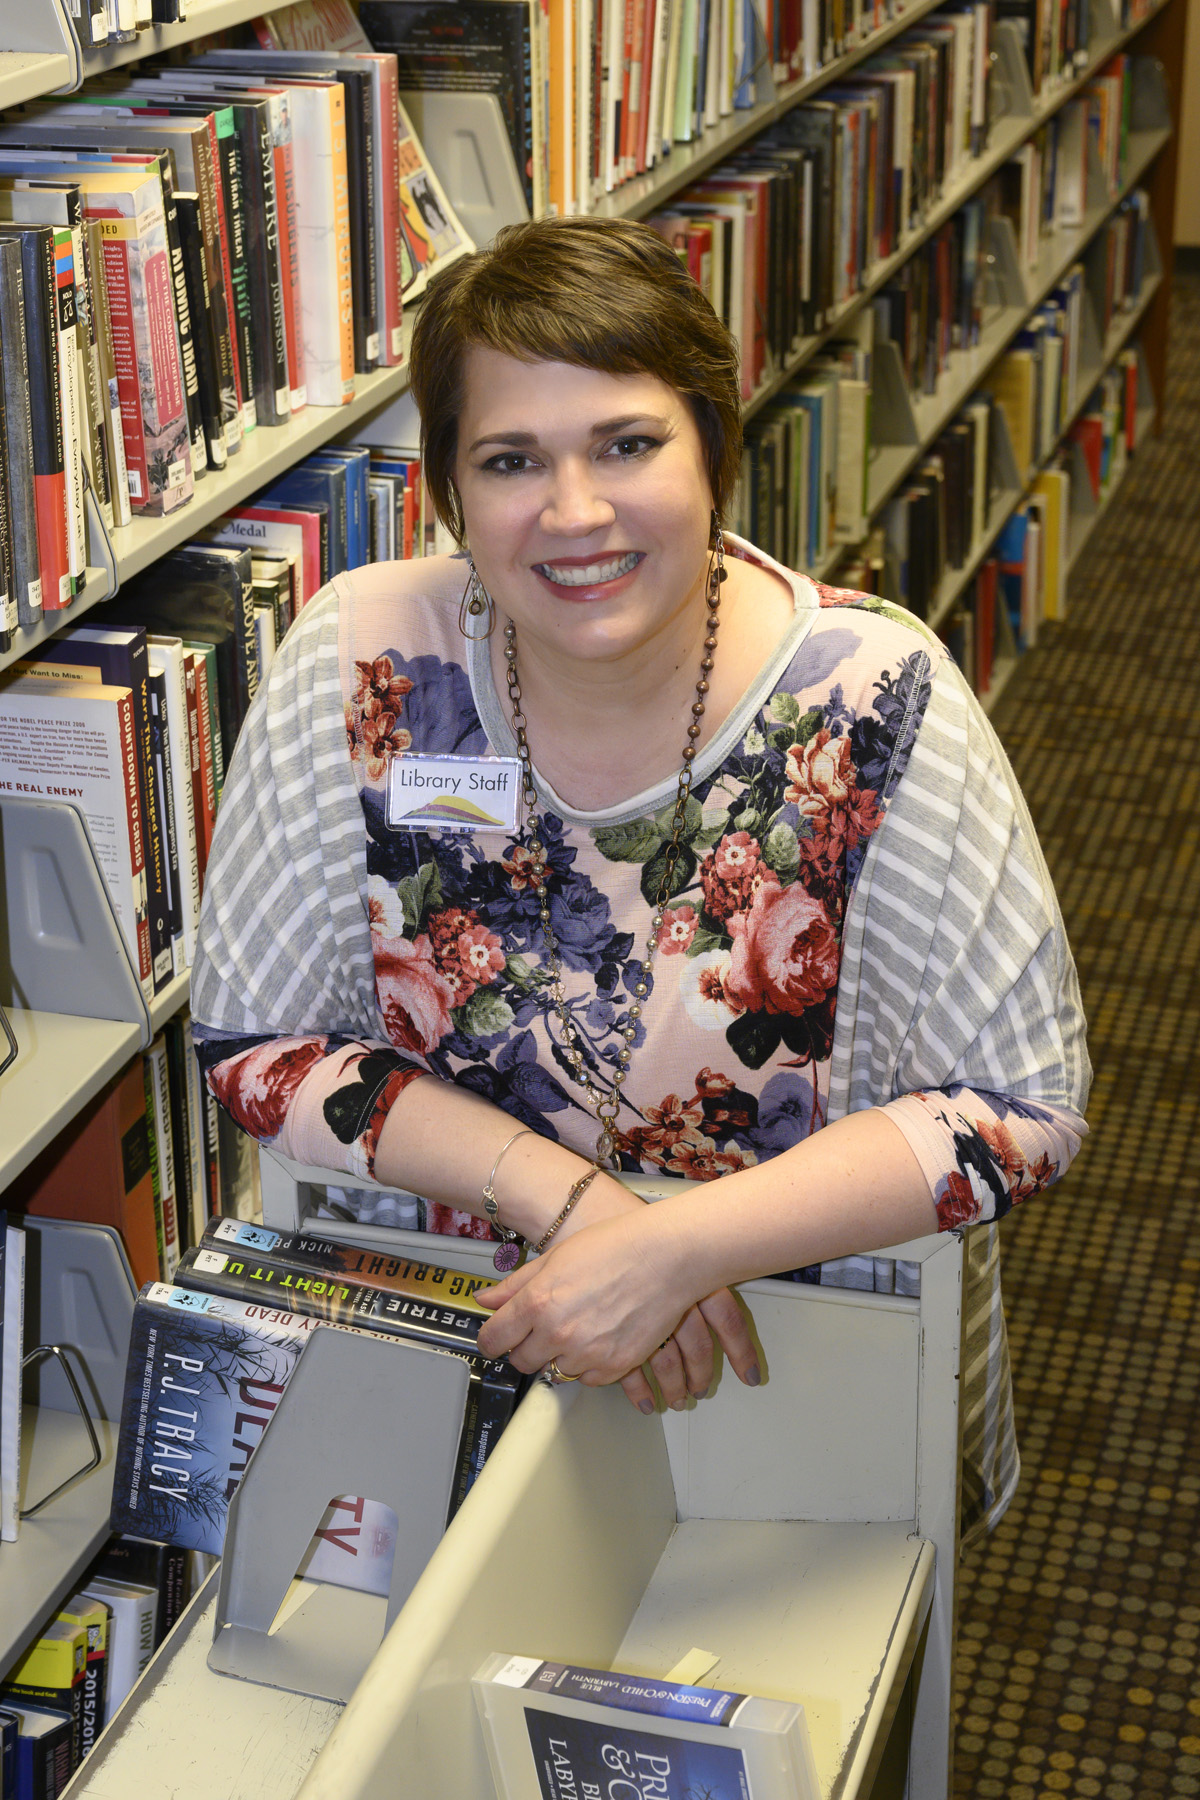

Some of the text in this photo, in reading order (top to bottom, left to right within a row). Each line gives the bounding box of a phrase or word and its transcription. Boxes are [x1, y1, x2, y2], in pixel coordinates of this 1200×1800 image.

[197, 144, 214, 246] HUMANITARIANS
[228, 150, 244, 258] THE IRAN THREAT
[284, 169, 299, 288] INSURGENTS
[333, 117, 352, 324] 15 MINUTES
[261, 131, 285, 364] EMPIRE JOHNSON
[48, 283, 53, 292] OF
[166, 308, 176, 360] COMMON
[172, 247, 198, 396] ATOMIC IRAN
[220, 334, 229, 376] HODGE
[18, 300, 28, 376] Innocence
[24, 379, 34, 469] Commission
[170, 361, 180, 408] DEFENSE
[67, 336, 76, 426] Encyclopedia
[72, 438, 80, 509] Everyday
[221, 520, 266, 538] Medal
[242, 582, 260, 700] ABOVE AND
[62, 672, 83, 680] Miss:
[190, 708, 200, 772] Nation-Building
[199, 668, 215, 812] WASHINGTON RULES
[214, 732, 223, 782] GRUNT
[0, 781, 83, 797] HE REAL ENEMY
[123, 702, 142, 867] COUNTDOWN TO CRISIS
[402, 769, 508, 794] Library Staff
[148, 766, 158, 832] Changed
[153, 836, 162, 894] History
[166, 768, 178, 854] Counterinsurgency
[186, 780, 199, 914] KNIFE FIGHTS
[158, 1052, 170, 1134] LICENSED
[166, 1154, 174, 1190] KILL
[224, 1224, 232, 1234] PET
[298, 1239, 334, 1254] NICK
[248, 1266, 351, 1301] LIGHT IT
[346, 1254, 448, 1286] BRIGHT
[244, 1304, 293, 1326] DEAD
[385, 1298, 470, 1329] PETRIE
[146, 1343, 156, 1358] YORK
[148, 1328, 158, 1342] NEW
[145, 1359, 154, 1378] TIMES
[140, 1377, 152, 1413] BESTSELLING
[137, 1414, 147, 1436] AUTHOR
[149, 1352, 204, 1502] P.J. TRACY
[133, 1445, 144, 1470] NOTHING
[476, 1430, 489, 1470] suspenseful
[131, 1470, 141, 1489] STAYS
[129, 1489, 139, 1510] BURIED
[166, 1558, 176, 1627] Companion to
[140, 1610, 153, 1650] HOW
[571, 1674, 620, 1688] LABYRINTH
[580, 1683, 602, 1692] BLUE
[621, 1685, 657, 1699] CHILD
[657, 1690, 667, 1698] &
[666, 1692, 712, 1708] PRESTON
[82, 1668, 98, 1758] 2015/2016
[601, 1744, 636, 1778] &
